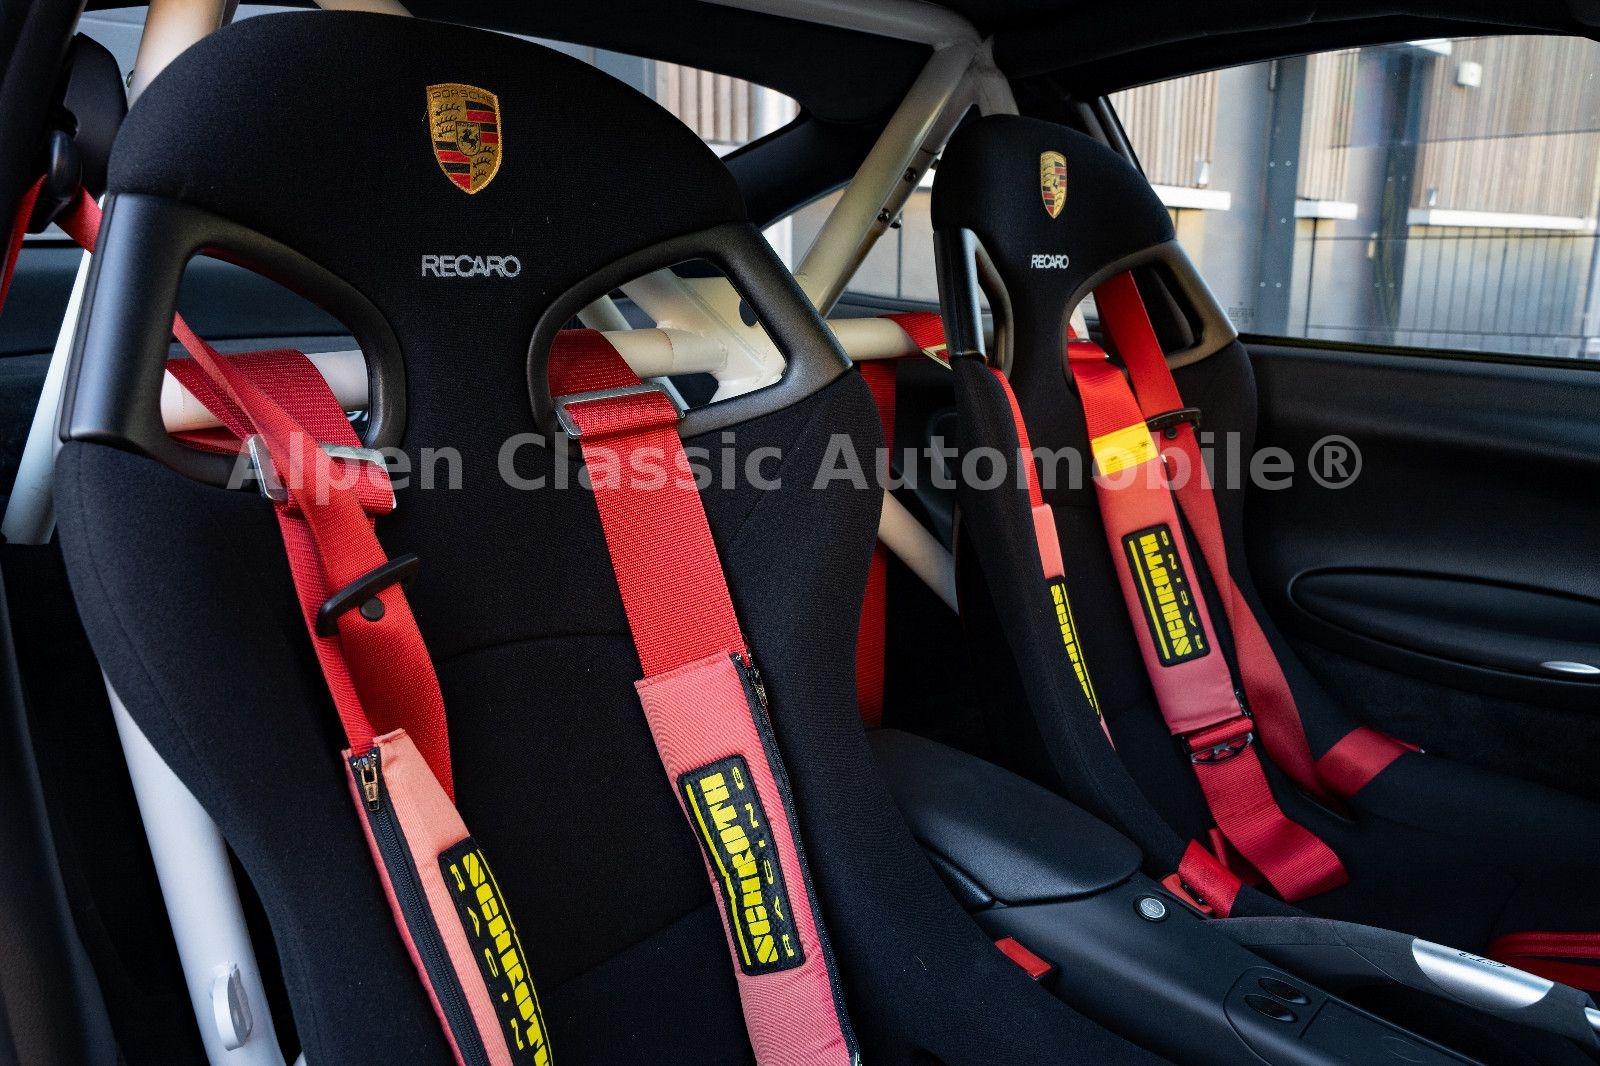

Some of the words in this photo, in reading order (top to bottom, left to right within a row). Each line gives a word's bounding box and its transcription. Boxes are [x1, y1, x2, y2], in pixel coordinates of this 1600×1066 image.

[421, 254, 521, 278] RECARO
[1030, 254, 1070, 270] RECARO
[1139, 533, 1193, 657] SCHROTH
[1160, 530, 1204, 650] RACING
[699, 772, 779, 964] SCHROTH
[732, 766, 795, 957] RACING
[450, 863, 525, 1051] RACIN
